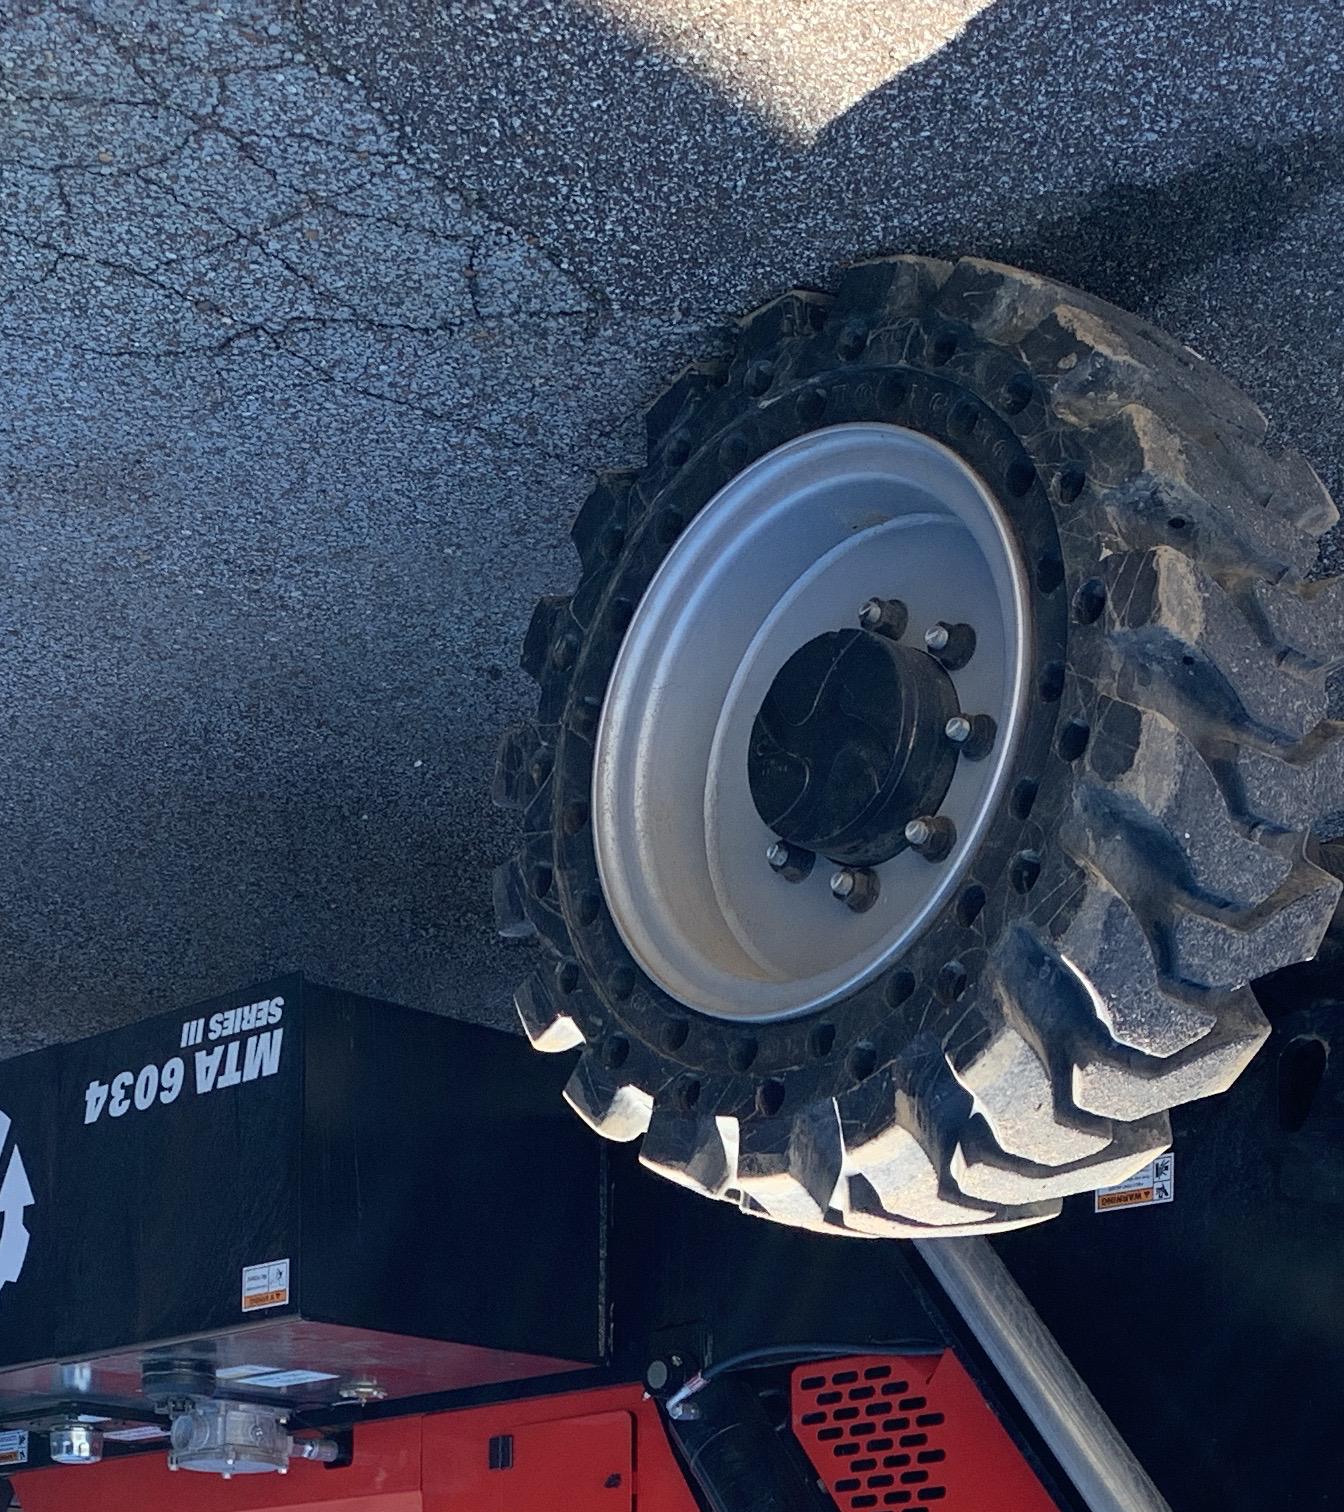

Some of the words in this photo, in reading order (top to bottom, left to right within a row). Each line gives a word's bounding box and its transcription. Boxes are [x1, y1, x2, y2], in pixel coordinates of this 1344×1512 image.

[179, 1017, 205, 1049] III
[207, 995, 285, 1041] SERIES
[194, 1027, 284, 1095] MTA
[84, 1056, 185, 1125] 6034
[1101, 1192, 1142, 1207] WARNING
